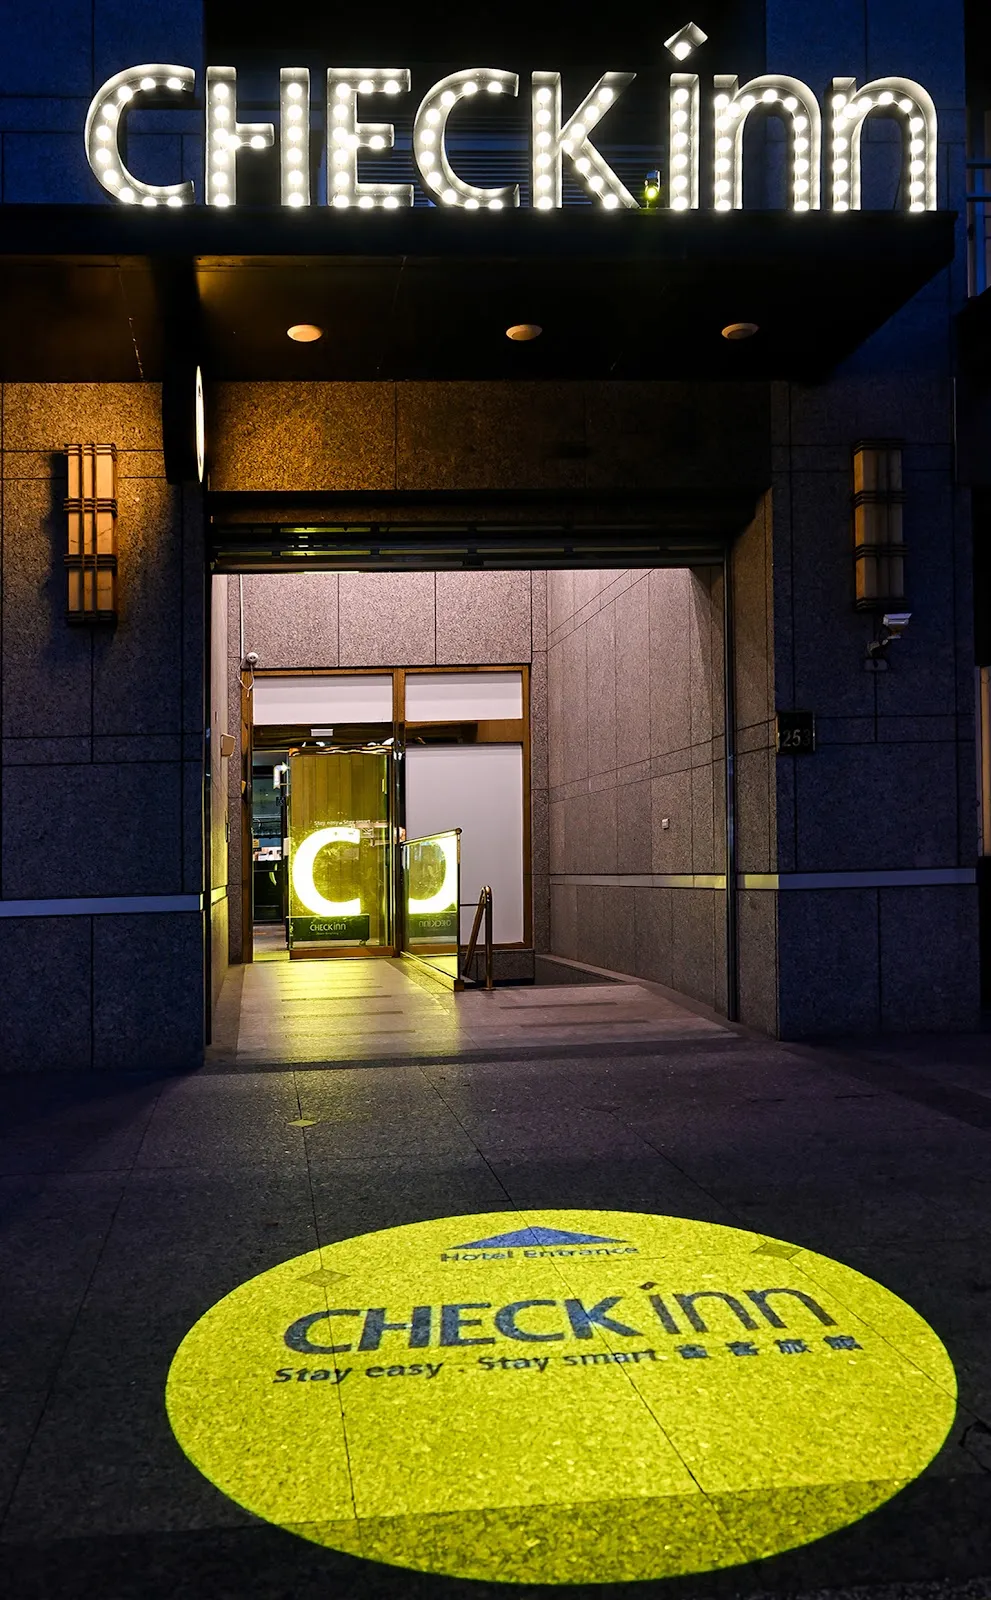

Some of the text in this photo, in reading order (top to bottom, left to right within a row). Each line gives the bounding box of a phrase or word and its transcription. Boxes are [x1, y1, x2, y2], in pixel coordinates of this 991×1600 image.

[440, 1247, 639, 1262] Hotel Entrance
[272, 1350, 656, 1386] Stay easy Stay smart
